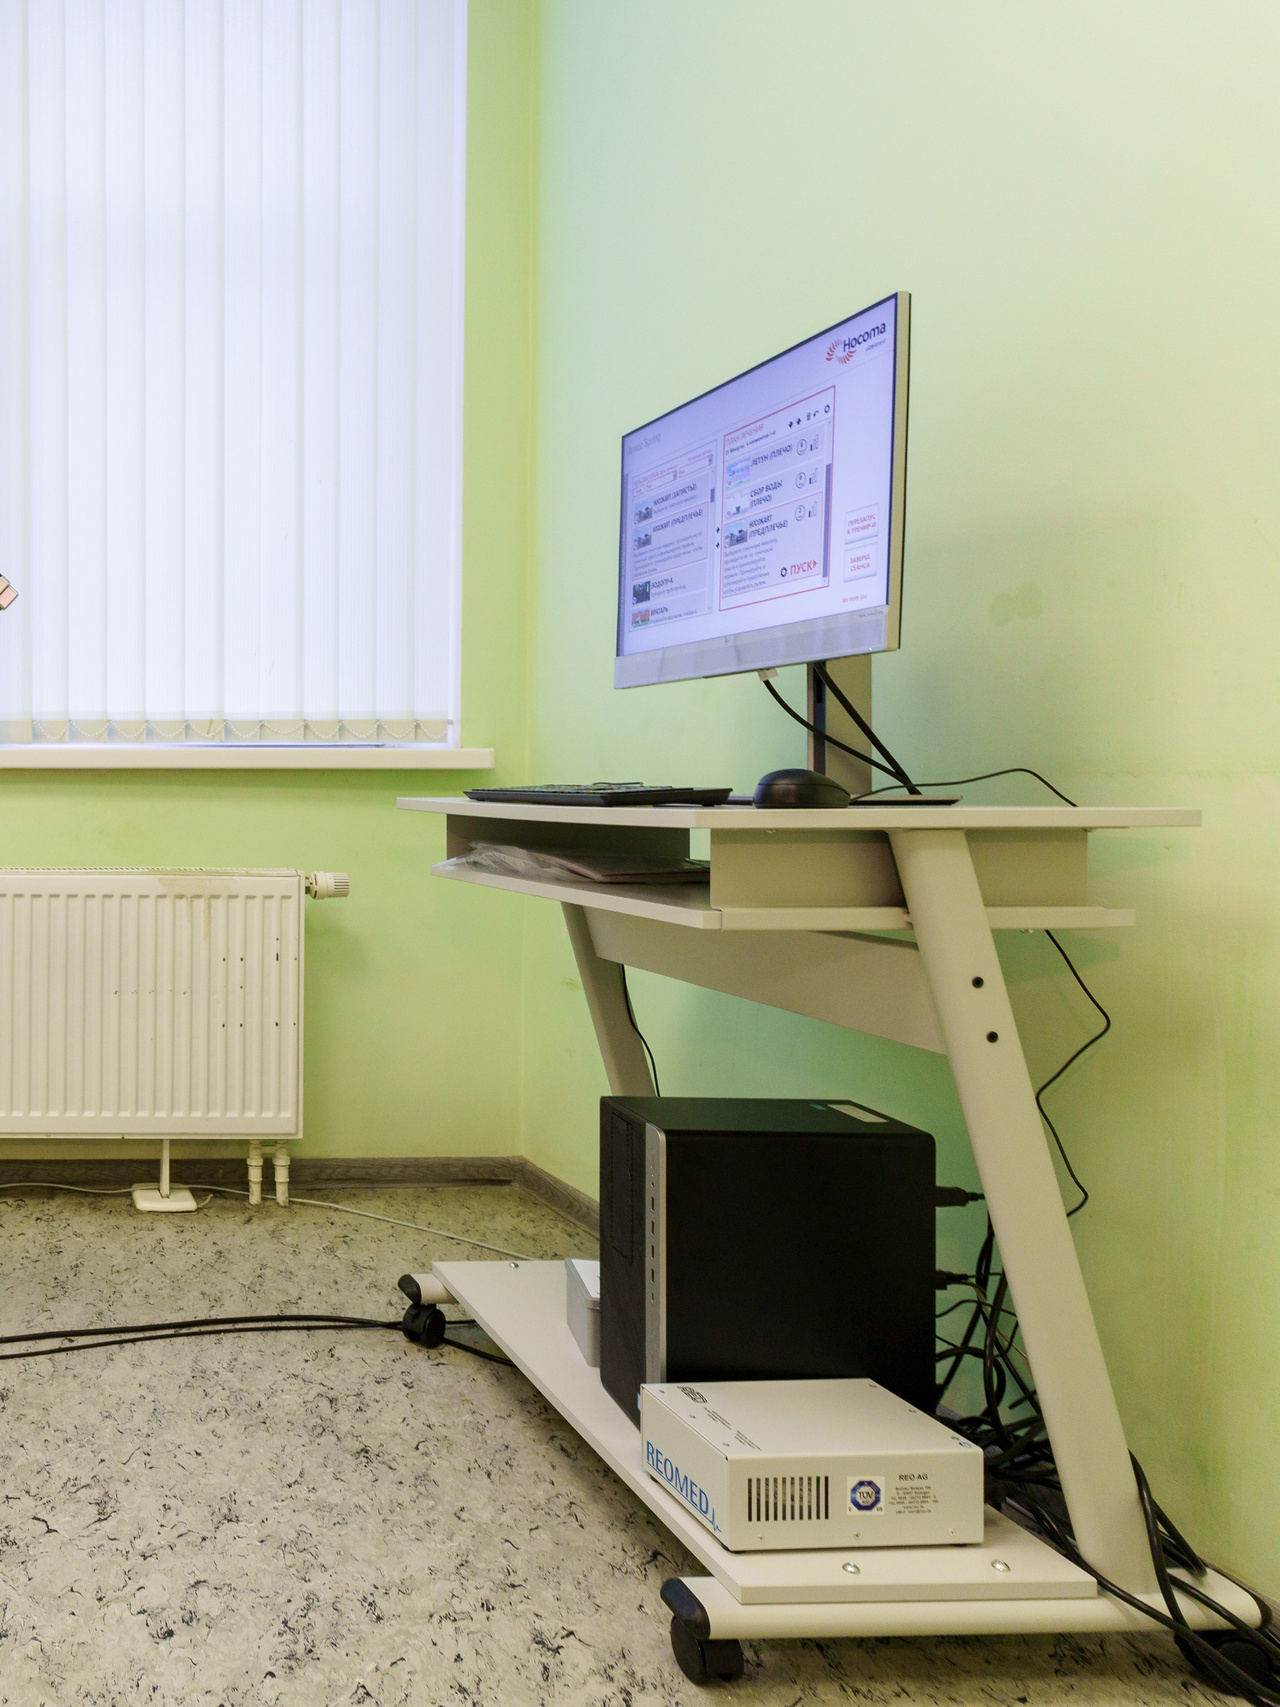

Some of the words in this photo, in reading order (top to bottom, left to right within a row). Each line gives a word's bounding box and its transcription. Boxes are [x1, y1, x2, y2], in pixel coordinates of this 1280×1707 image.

[843, 323, 886, 352] Hocoma
[750, 486, 765, 498] СБОР
[767, 480, 782, 492] ВОДЫ
[790, 561, 812, 574] ПУСК
[647, 1440, 709, 1514] REOMED
